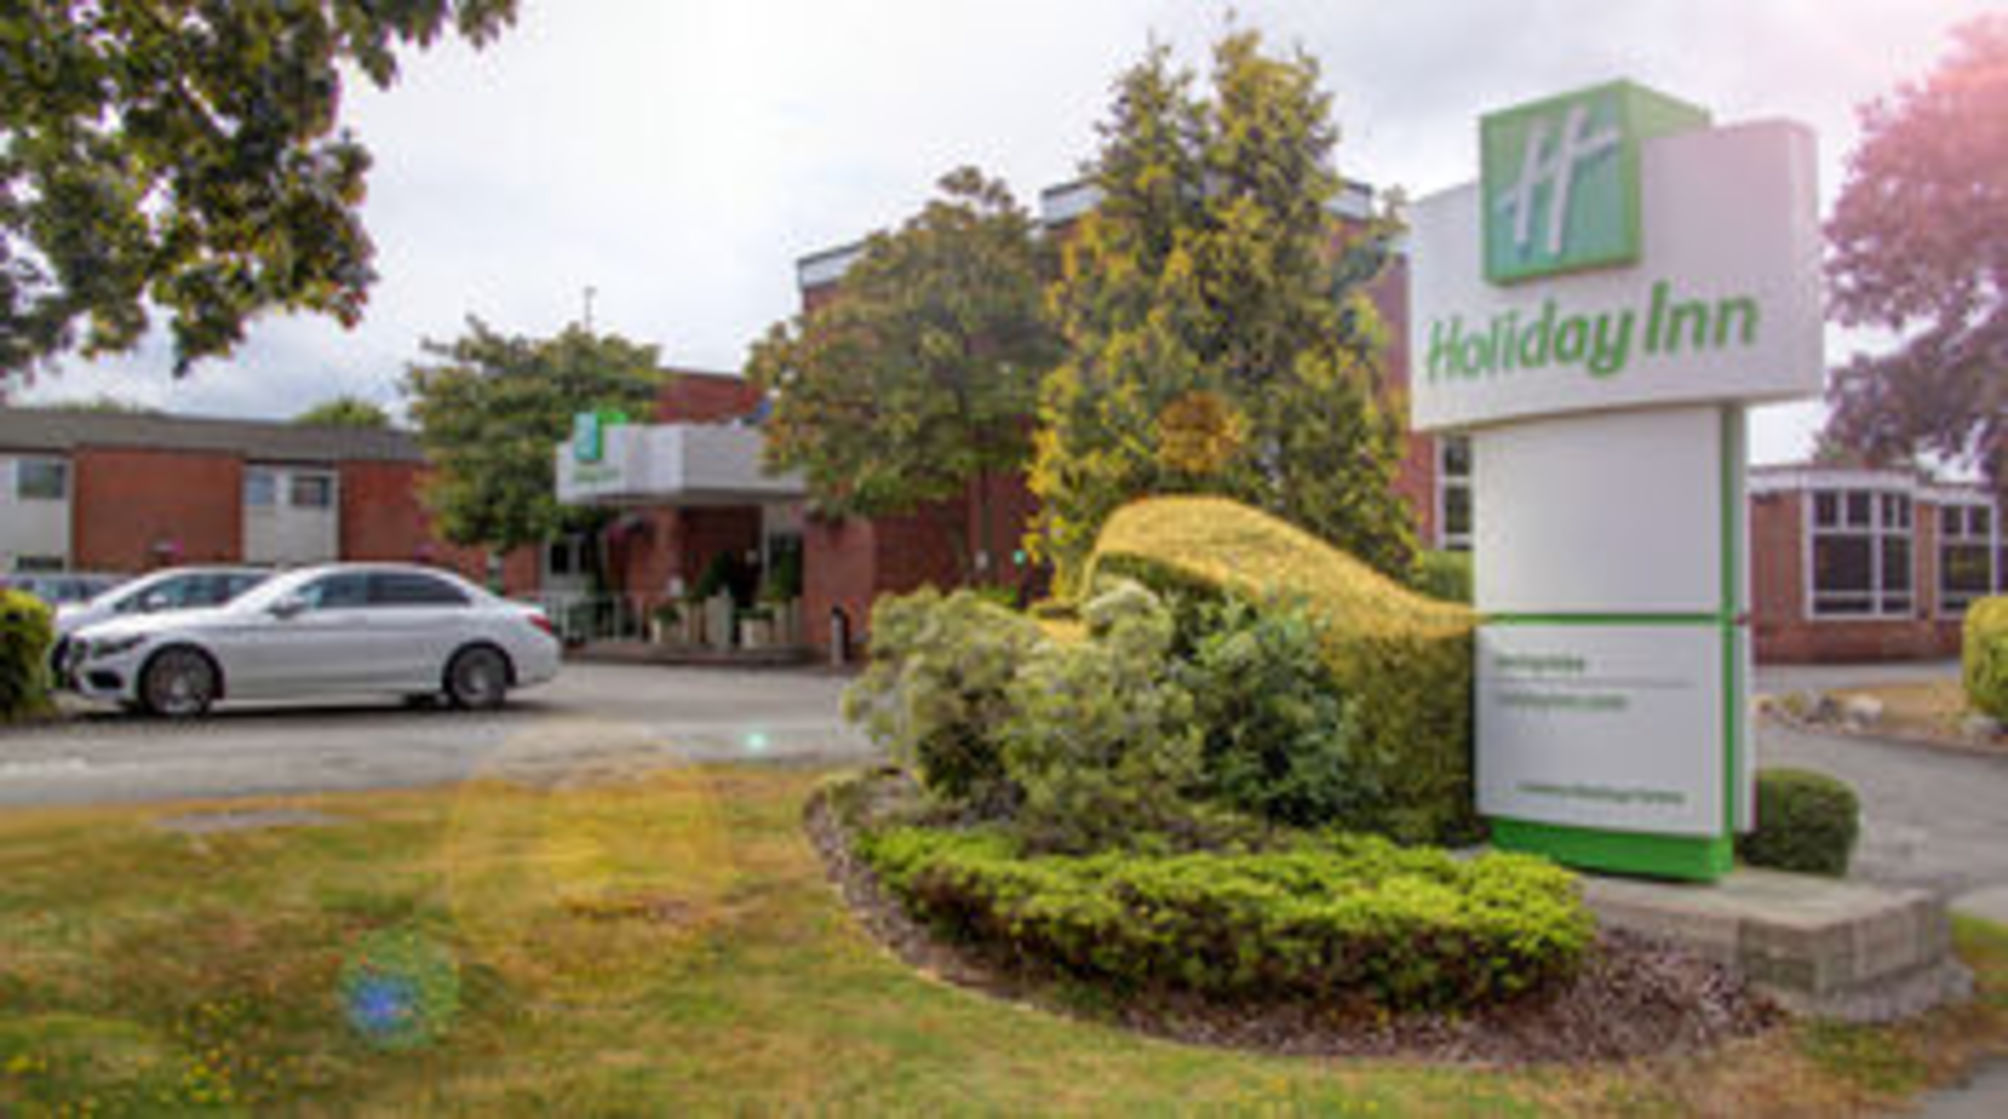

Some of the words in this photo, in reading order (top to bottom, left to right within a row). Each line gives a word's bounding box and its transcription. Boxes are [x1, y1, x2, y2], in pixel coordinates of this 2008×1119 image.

[1495, 103, 1620, 256] H
[1427, 298, 1635, 384] Holiday
[1643, 279, 1758, 355] Inn
